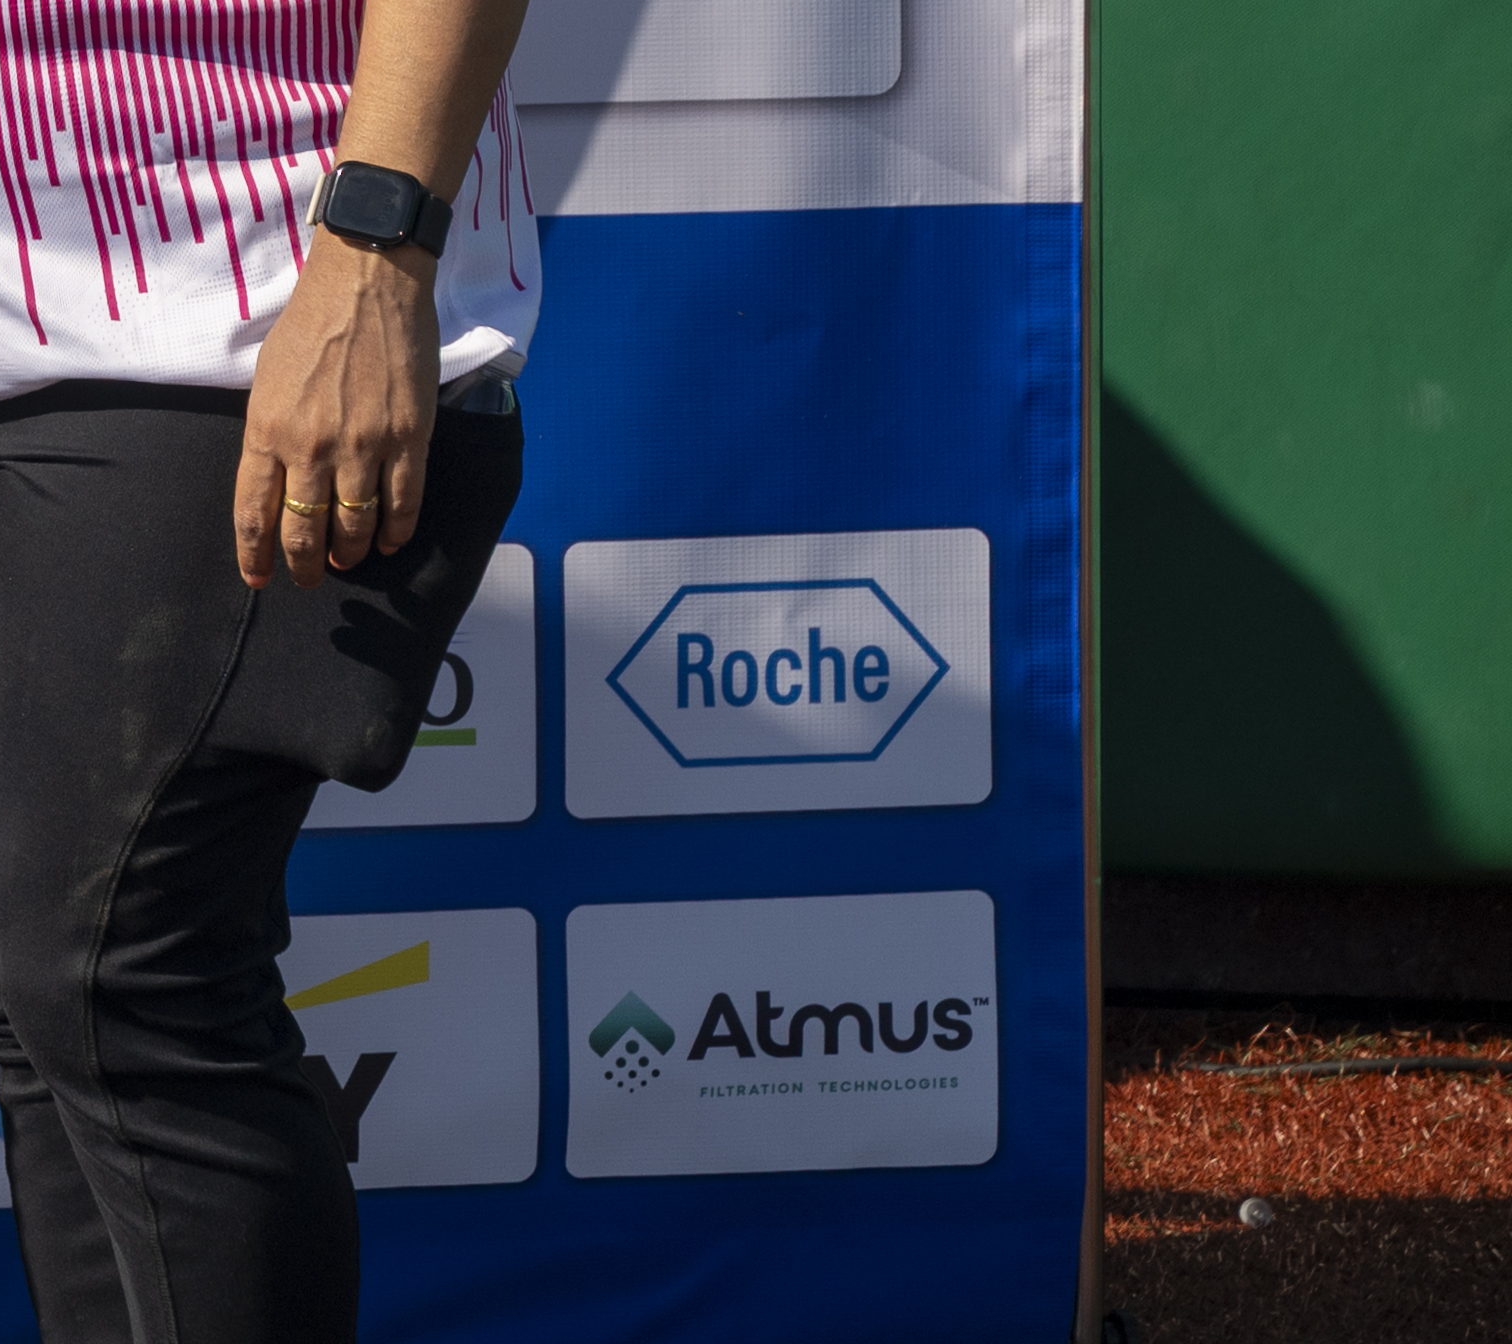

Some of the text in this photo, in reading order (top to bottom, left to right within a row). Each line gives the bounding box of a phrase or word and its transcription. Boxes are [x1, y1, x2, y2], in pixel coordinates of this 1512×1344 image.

[675, 628, 890, 708] Roche
[700, 1077, 959, 1098] FILTRATION TECHNOLOGIES
